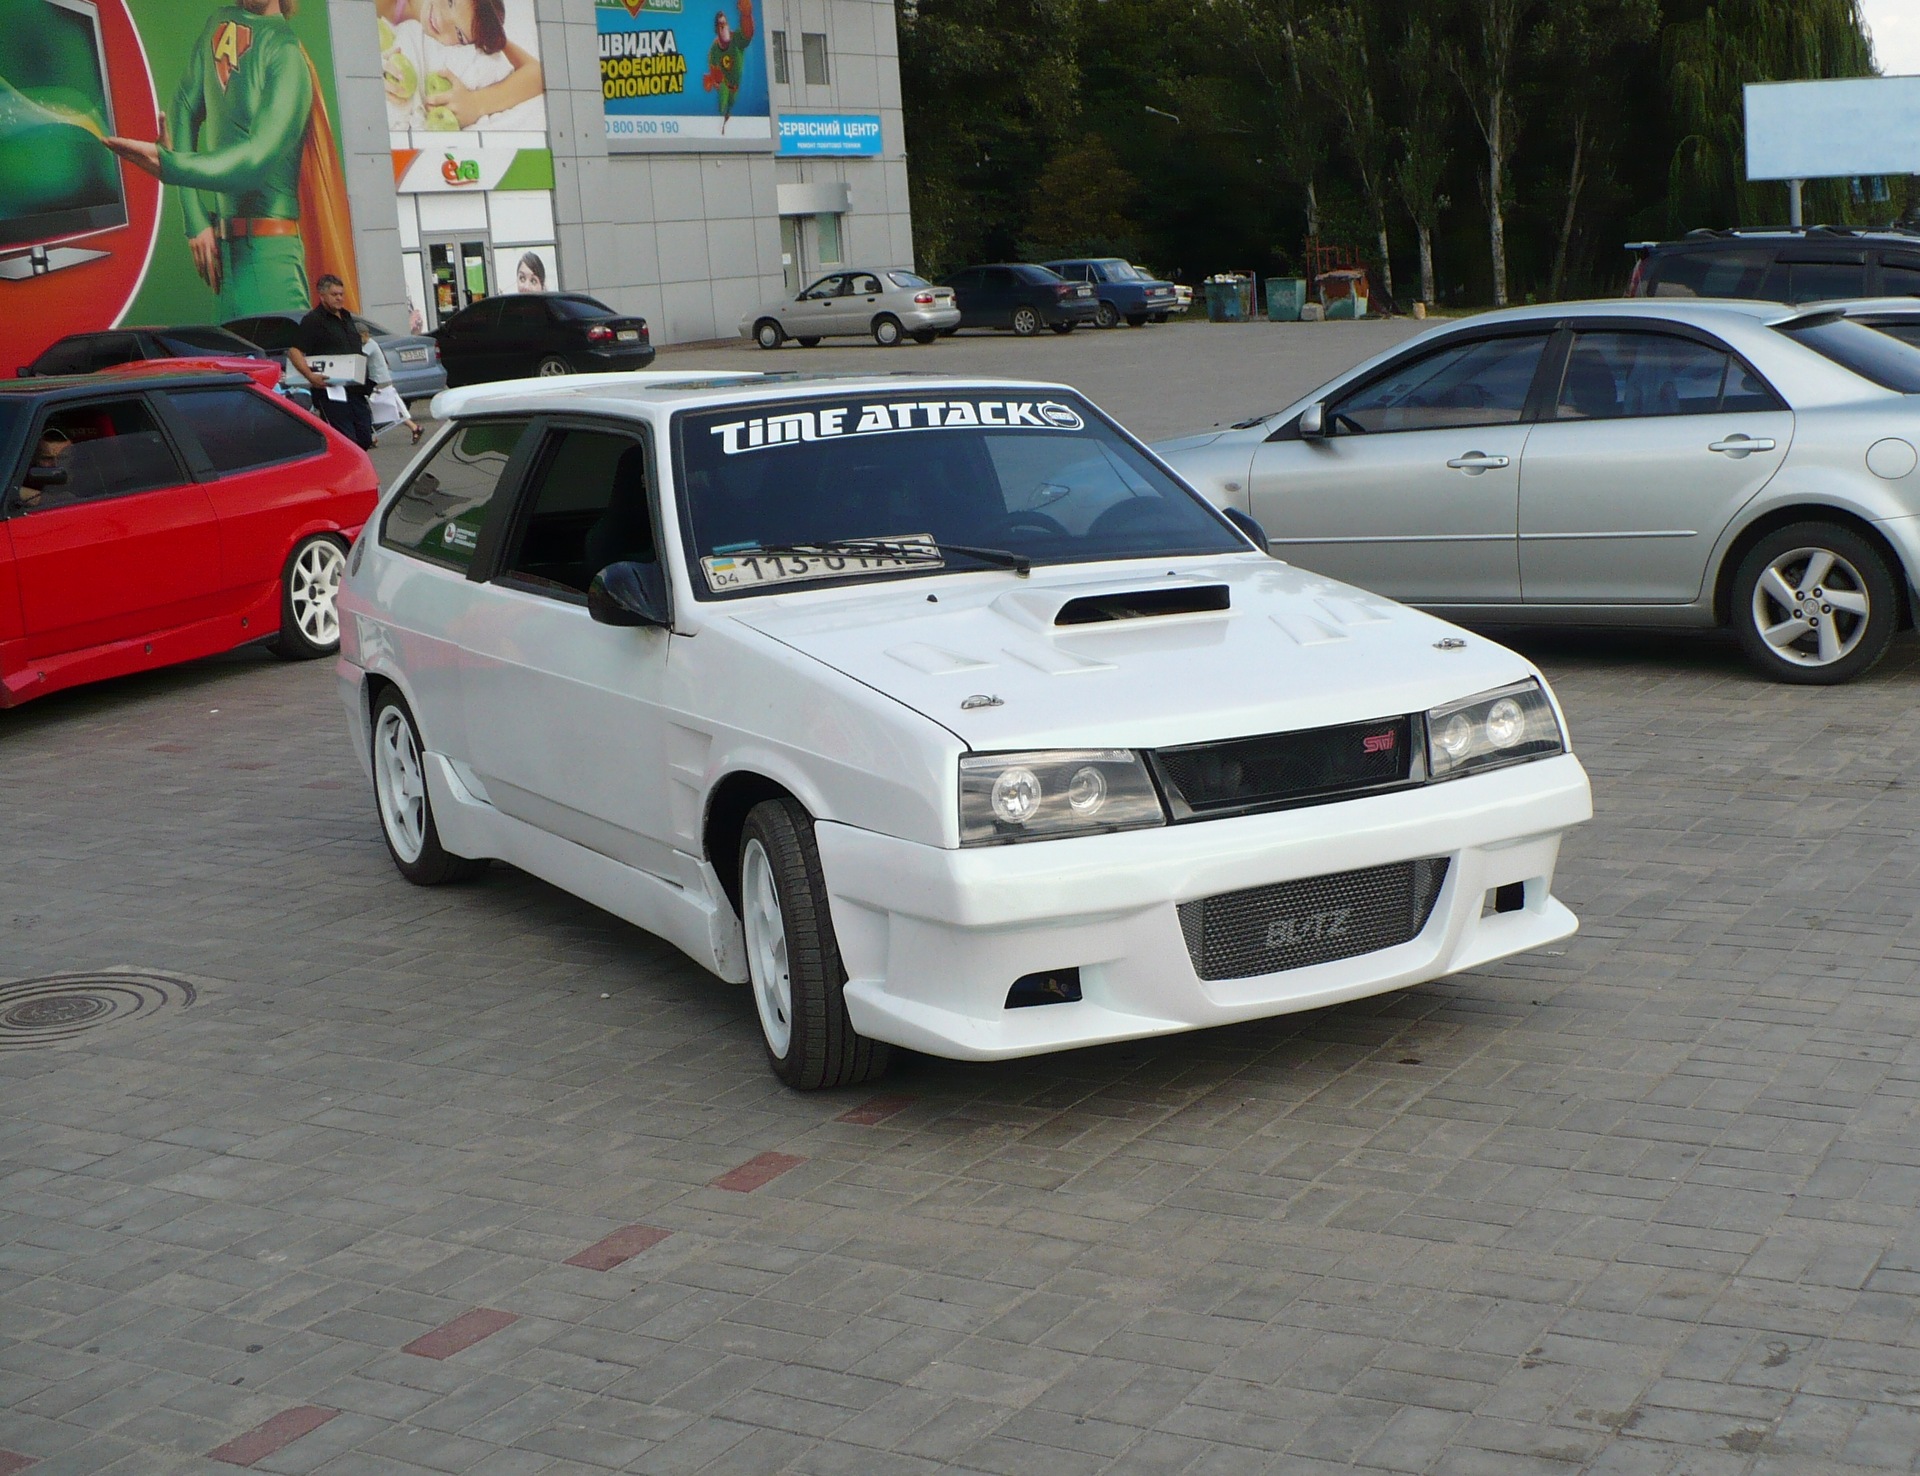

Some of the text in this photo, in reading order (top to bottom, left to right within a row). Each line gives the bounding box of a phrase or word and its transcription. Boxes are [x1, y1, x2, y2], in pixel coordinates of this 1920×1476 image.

[600, 53, 687, 79] РОФЕСІЙНА
[603, 73, 684, 99] ОПОМОГА!
[612, 120, 634, 134] 800
[636, 120, 658, 134] 500
[660, 120, 680, 134] 190
[778, 120, 880, 139] СЕРВІСНИЙ ЦЕНТР
[855, 401, 1046, 430] ATTACK
[716, 572, 740, 587] 04
